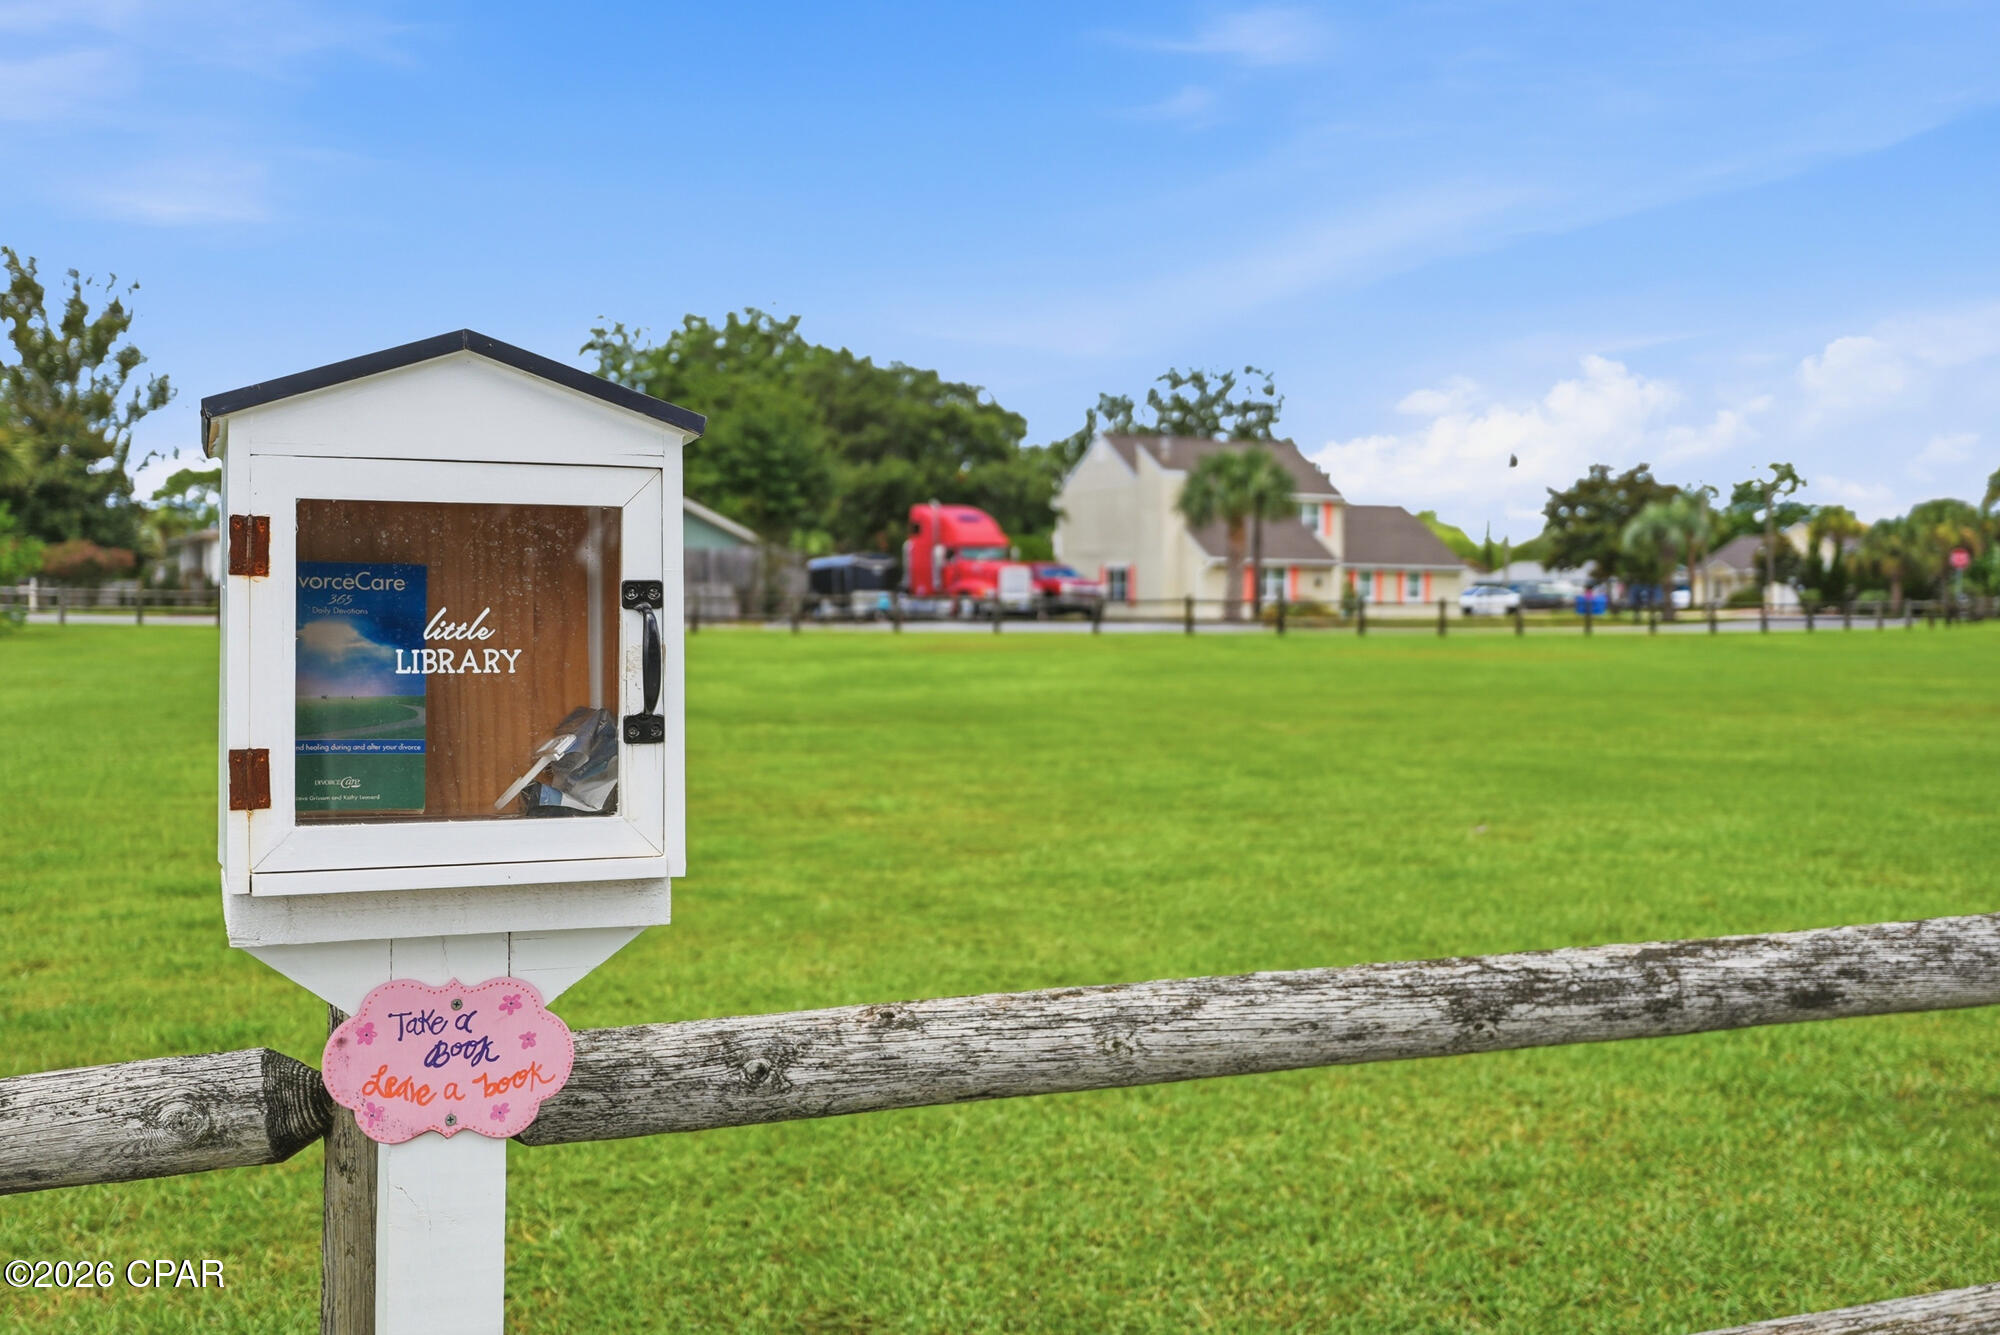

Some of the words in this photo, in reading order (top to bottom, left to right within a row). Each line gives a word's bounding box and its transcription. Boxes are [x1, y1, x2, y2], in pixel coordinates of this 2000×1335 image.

[311, 606, 331, 615] Daily
[327, 593, 353, 606] 365
[423, 607, 496, 641] little
[395, 649, 522, 674] LIBRARY
[305, 743, 330, 753] healing
[330, 743, 352, 753] during
[352, 743, 366, 751] and
[366, 743, 381, 752] after
[382, 744, 398, 752] your
[398, 743, 421, 751] divorce
[388, 1009, 449, 1041] Take
[454, 1010, 478, 1034] a
[424, 1035, 500, 1068] Book
[443, 1082, 466, 1101] a
[472, 1061, 556, 1098] book
